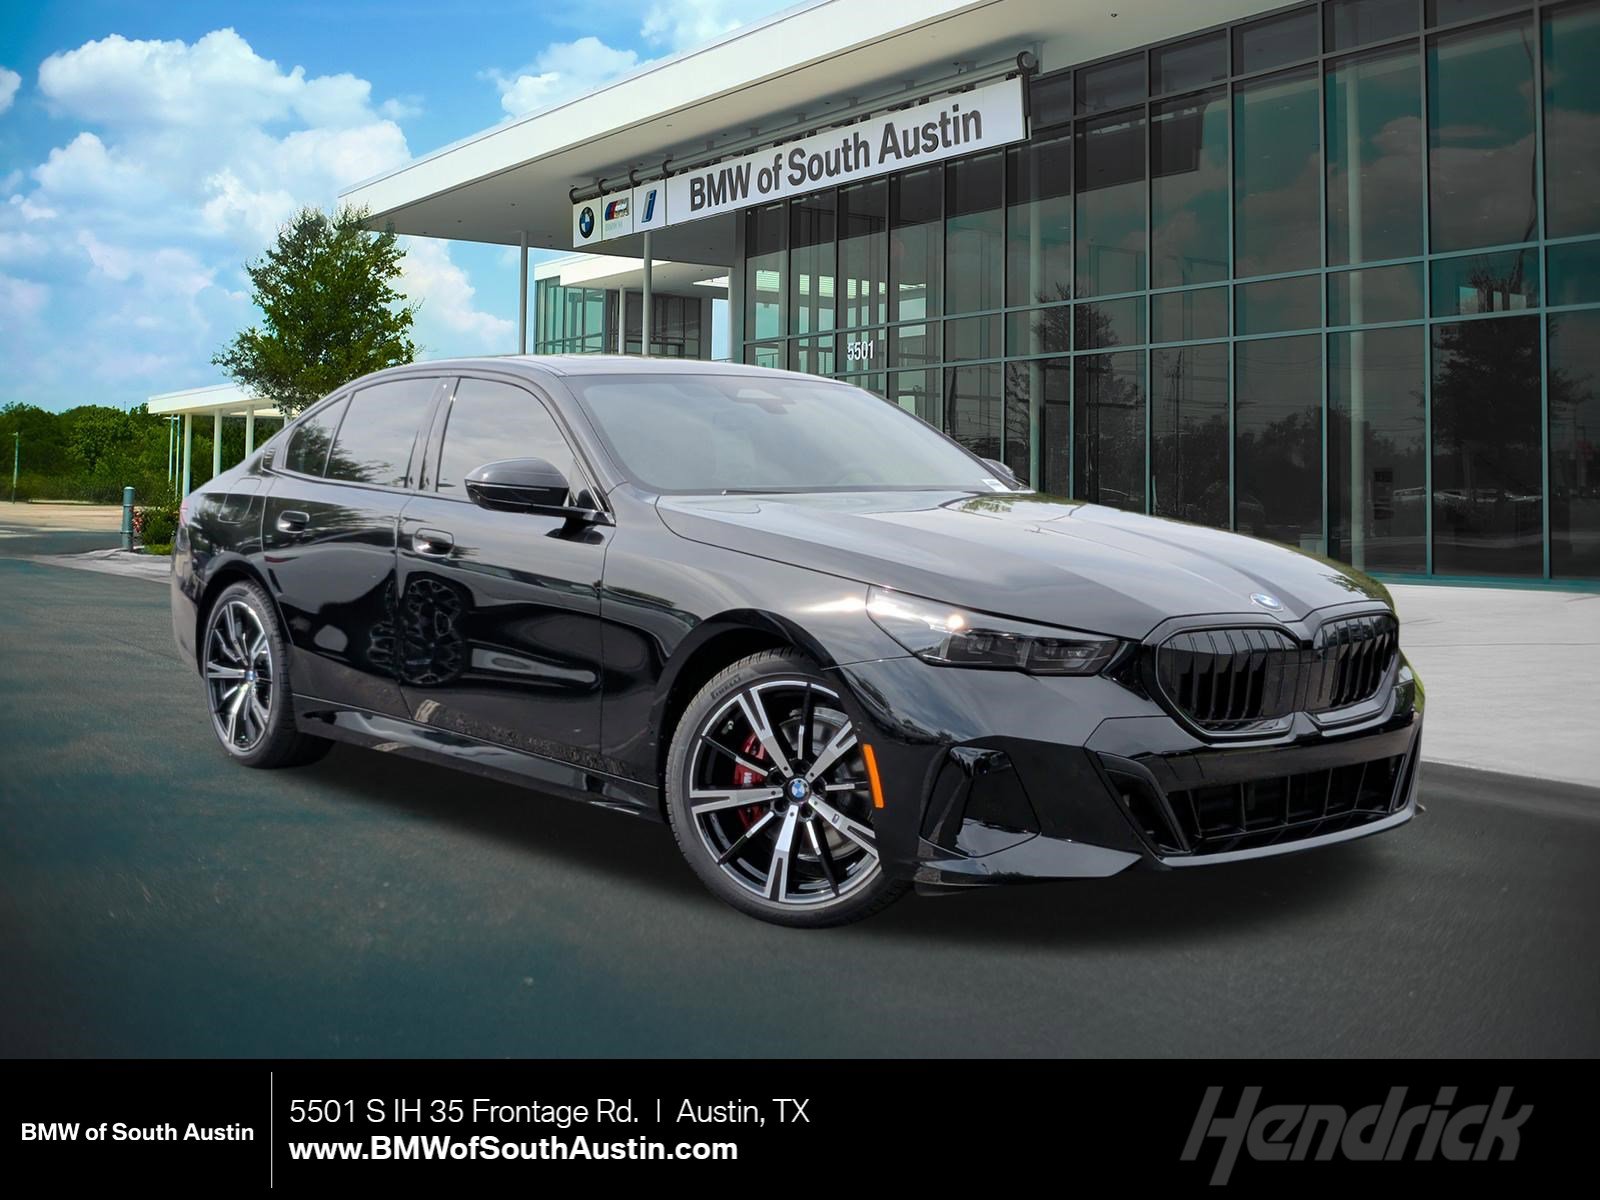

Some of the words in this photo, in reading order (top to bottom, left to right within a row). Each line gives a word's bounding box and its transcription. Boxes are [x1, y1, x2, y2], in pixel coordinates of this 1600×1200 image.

[690, 162, 752, 212] BMW
[757, 153, 784, 195] of
[787, 132, 871, 187] South
[878, 104, 983, 165] Austin
[847, 340, 874, 361] 5501
